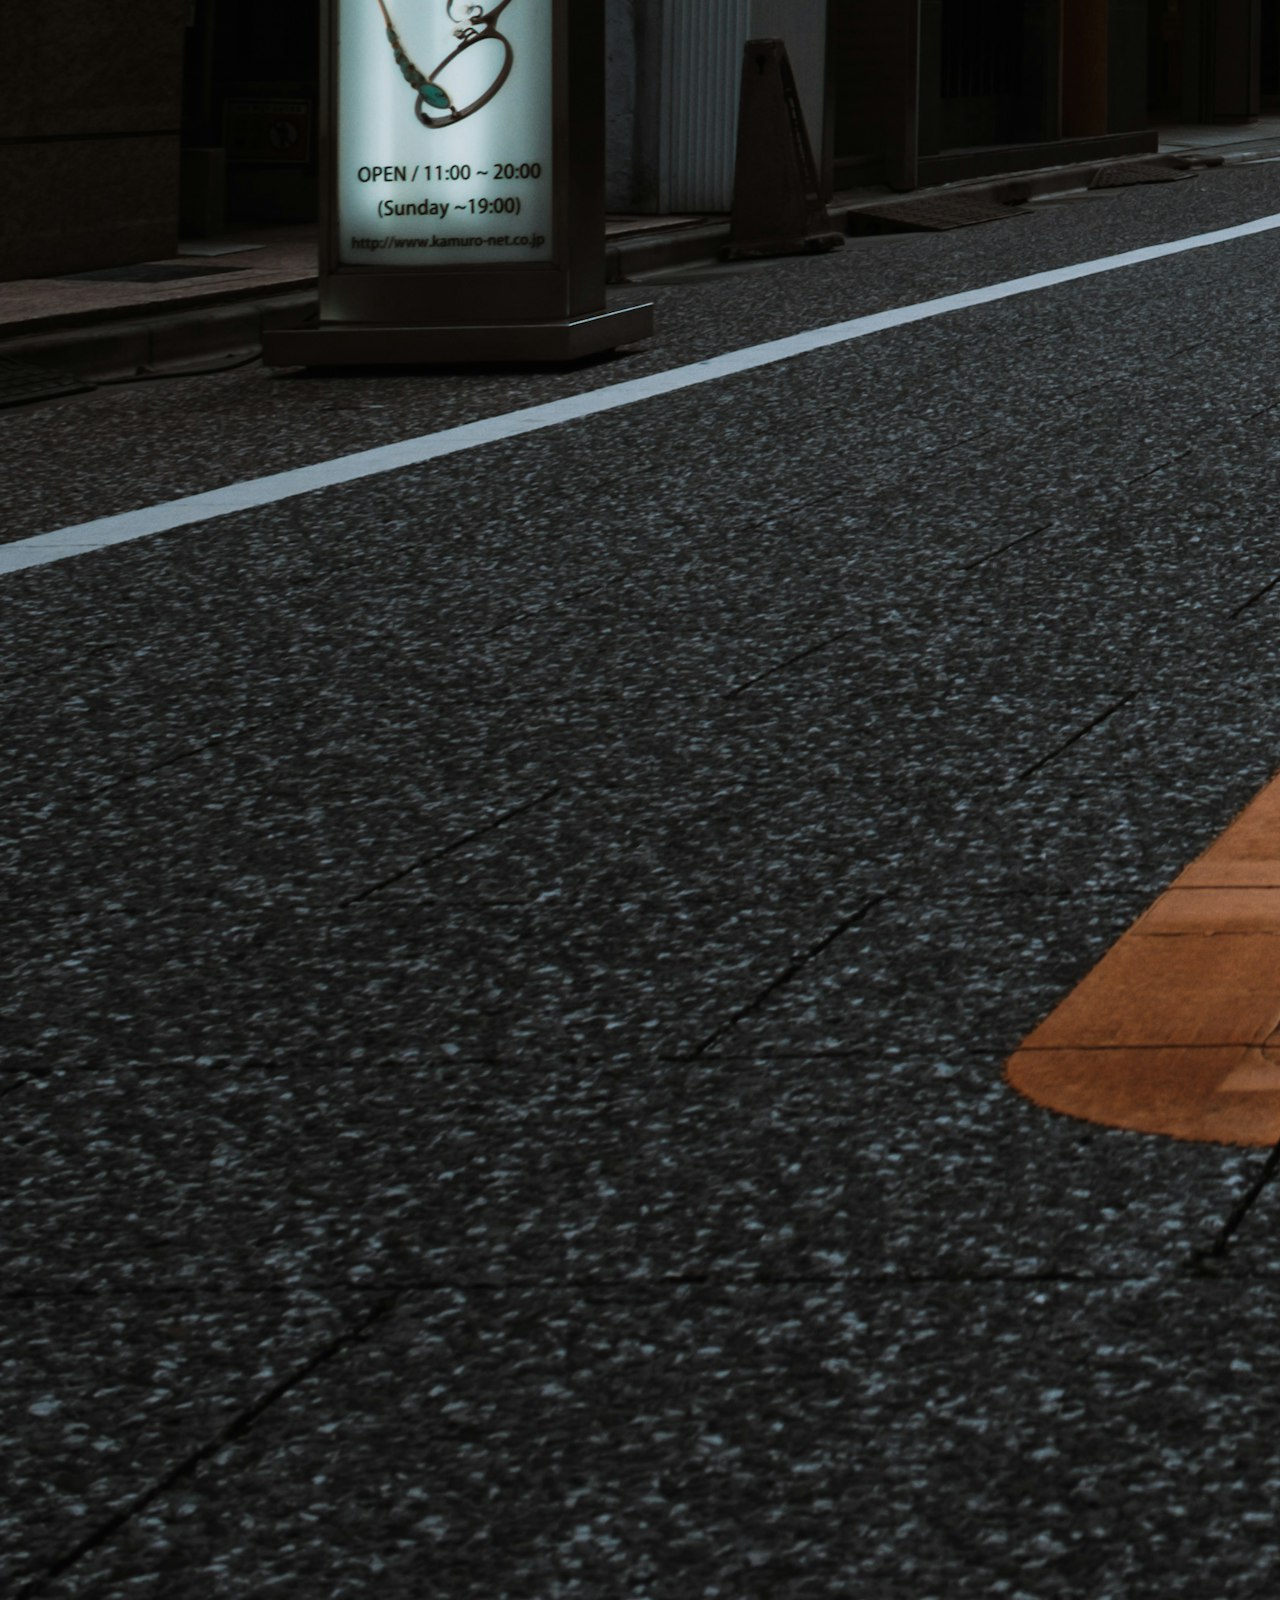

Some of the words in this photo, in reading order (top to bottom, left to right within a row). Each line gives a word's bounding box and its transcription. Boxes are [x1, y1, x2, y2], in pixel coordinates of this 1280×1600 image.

[358, 165, 406, 184] OPEN
[411, 165, 419, 185] /
[424, 164, 471, 182] 11:00
[493, 162, 541, 181] 20:00
[377, 199, 449, 220] (Sunday
[351, 233, 545, 250] http://www.kamuro-net.co.jp
